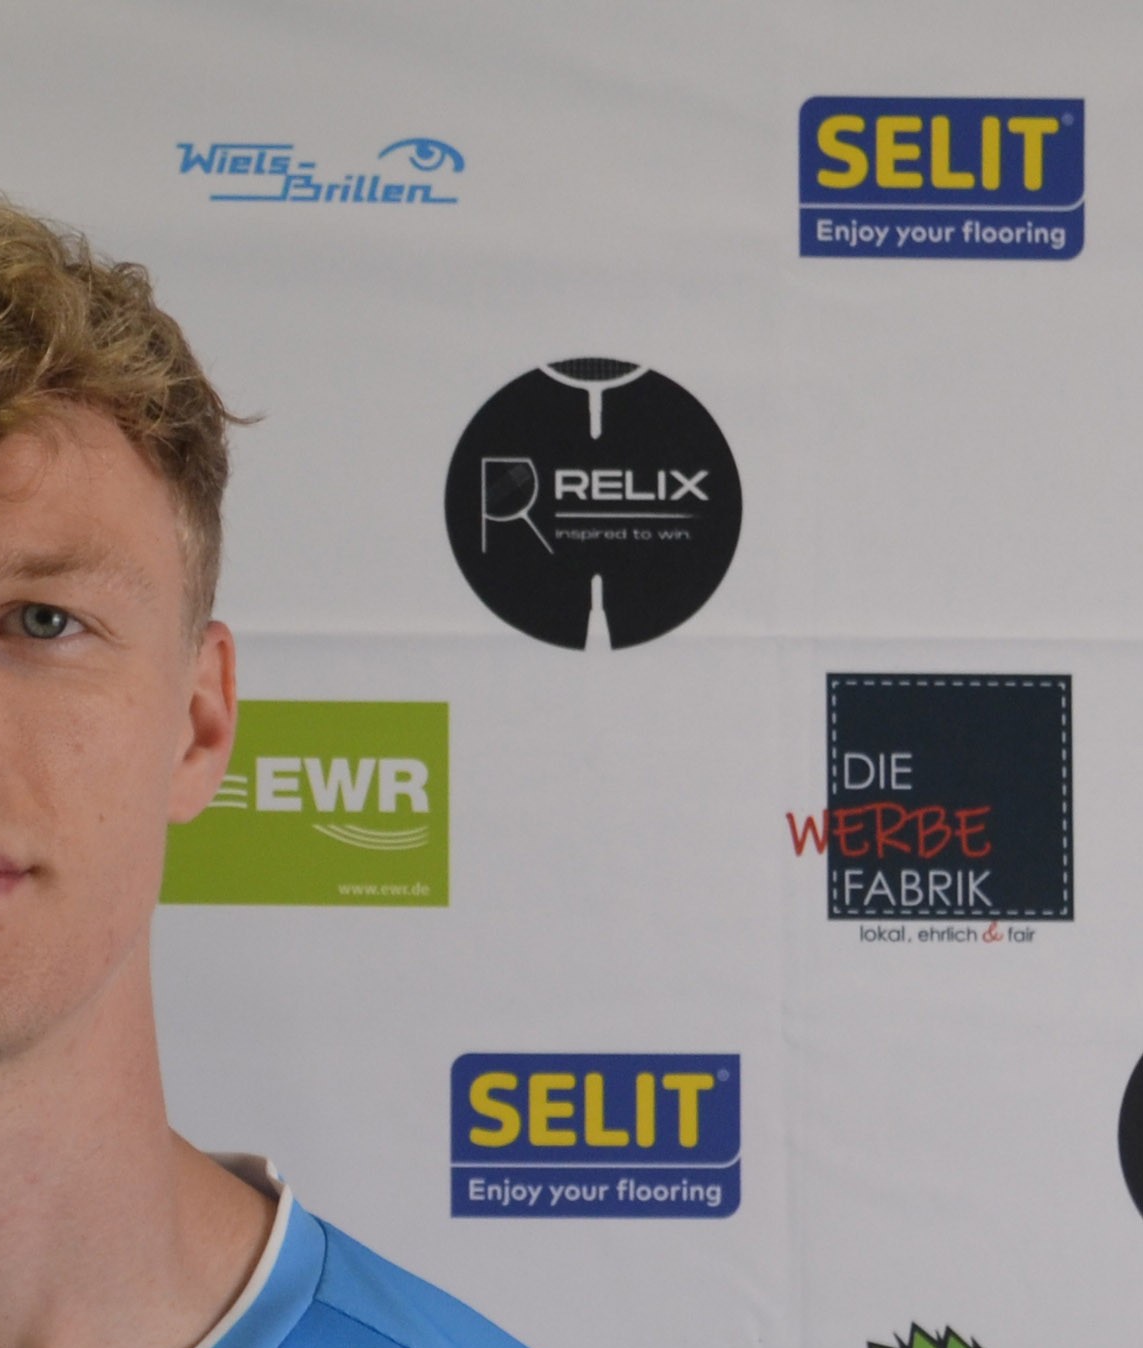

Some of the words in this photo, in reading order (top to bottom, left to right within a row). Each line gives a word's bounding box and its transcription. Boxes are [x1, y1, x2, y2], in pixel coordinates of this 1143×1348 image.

[817, 114, 1059, 191] SELIT
[280, 173, 433, 204] Brillen
[816, 219, 889, 247] Enjoy
[896, 224, 955, 247] your
[962, 220, 1066, 250] flooring
[555, 469, 709, 501] RELIX
[556, 527, 627, 541] inspired
[633, 528, 652, 540] to
[658, 529, 691, 540] win
[256, 756, 430, 813] EWR
[844, 752, 913, 790] DIE
[786, 802, 992, 860] WERBE
[338, 882, 431, 896] www.ewr.de
[844, 869, 994, 907] FABRIK
[918, 926, 978, 943] ehrlich
[982, 919, 1004, 943] &
[1007, 926, 1036, 943] fair
[469, 1071, 715, 1148] SELIT
[468, 1178, 542, 1206] Enjoy
[549, 1184, 609, 1206] your
[616, 1178, 722, 1207] flooring
